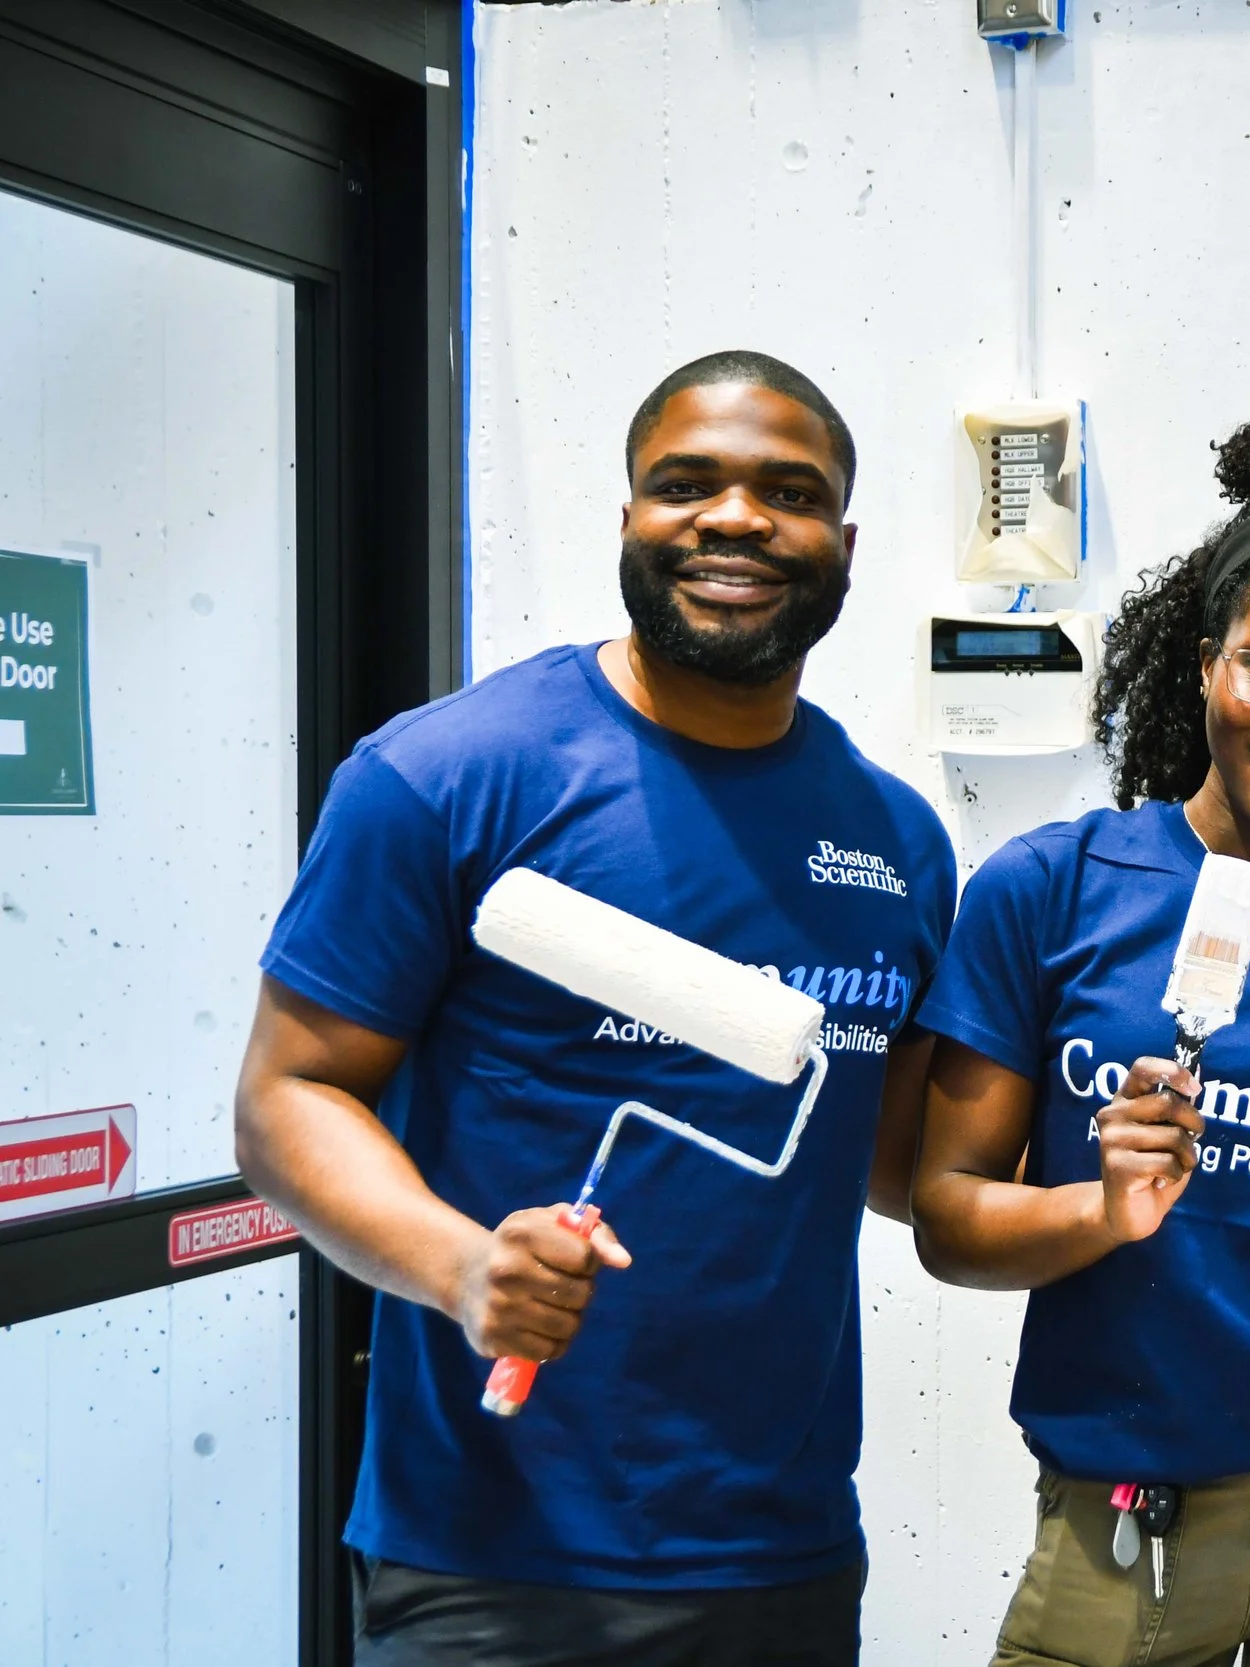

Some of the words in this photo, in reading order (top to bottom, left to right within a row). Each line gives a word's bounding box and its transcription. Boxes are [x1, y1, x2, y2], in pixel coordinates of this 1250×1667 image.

[11, 612, 54, 646] Use
[0, 655, 58, 690] Door
[817, 840, 887, 872] Boston
[807, 854, 907, 897] Scientific
[744, 950, 911, 1030] unity
[24, 1150, 68, 1183] SLIDING
[70, 1146, 100, 1174] DOOR
[178, 1223, 190, 1255] IN
[192, 1207, 262, 1252] EMERGENCY
